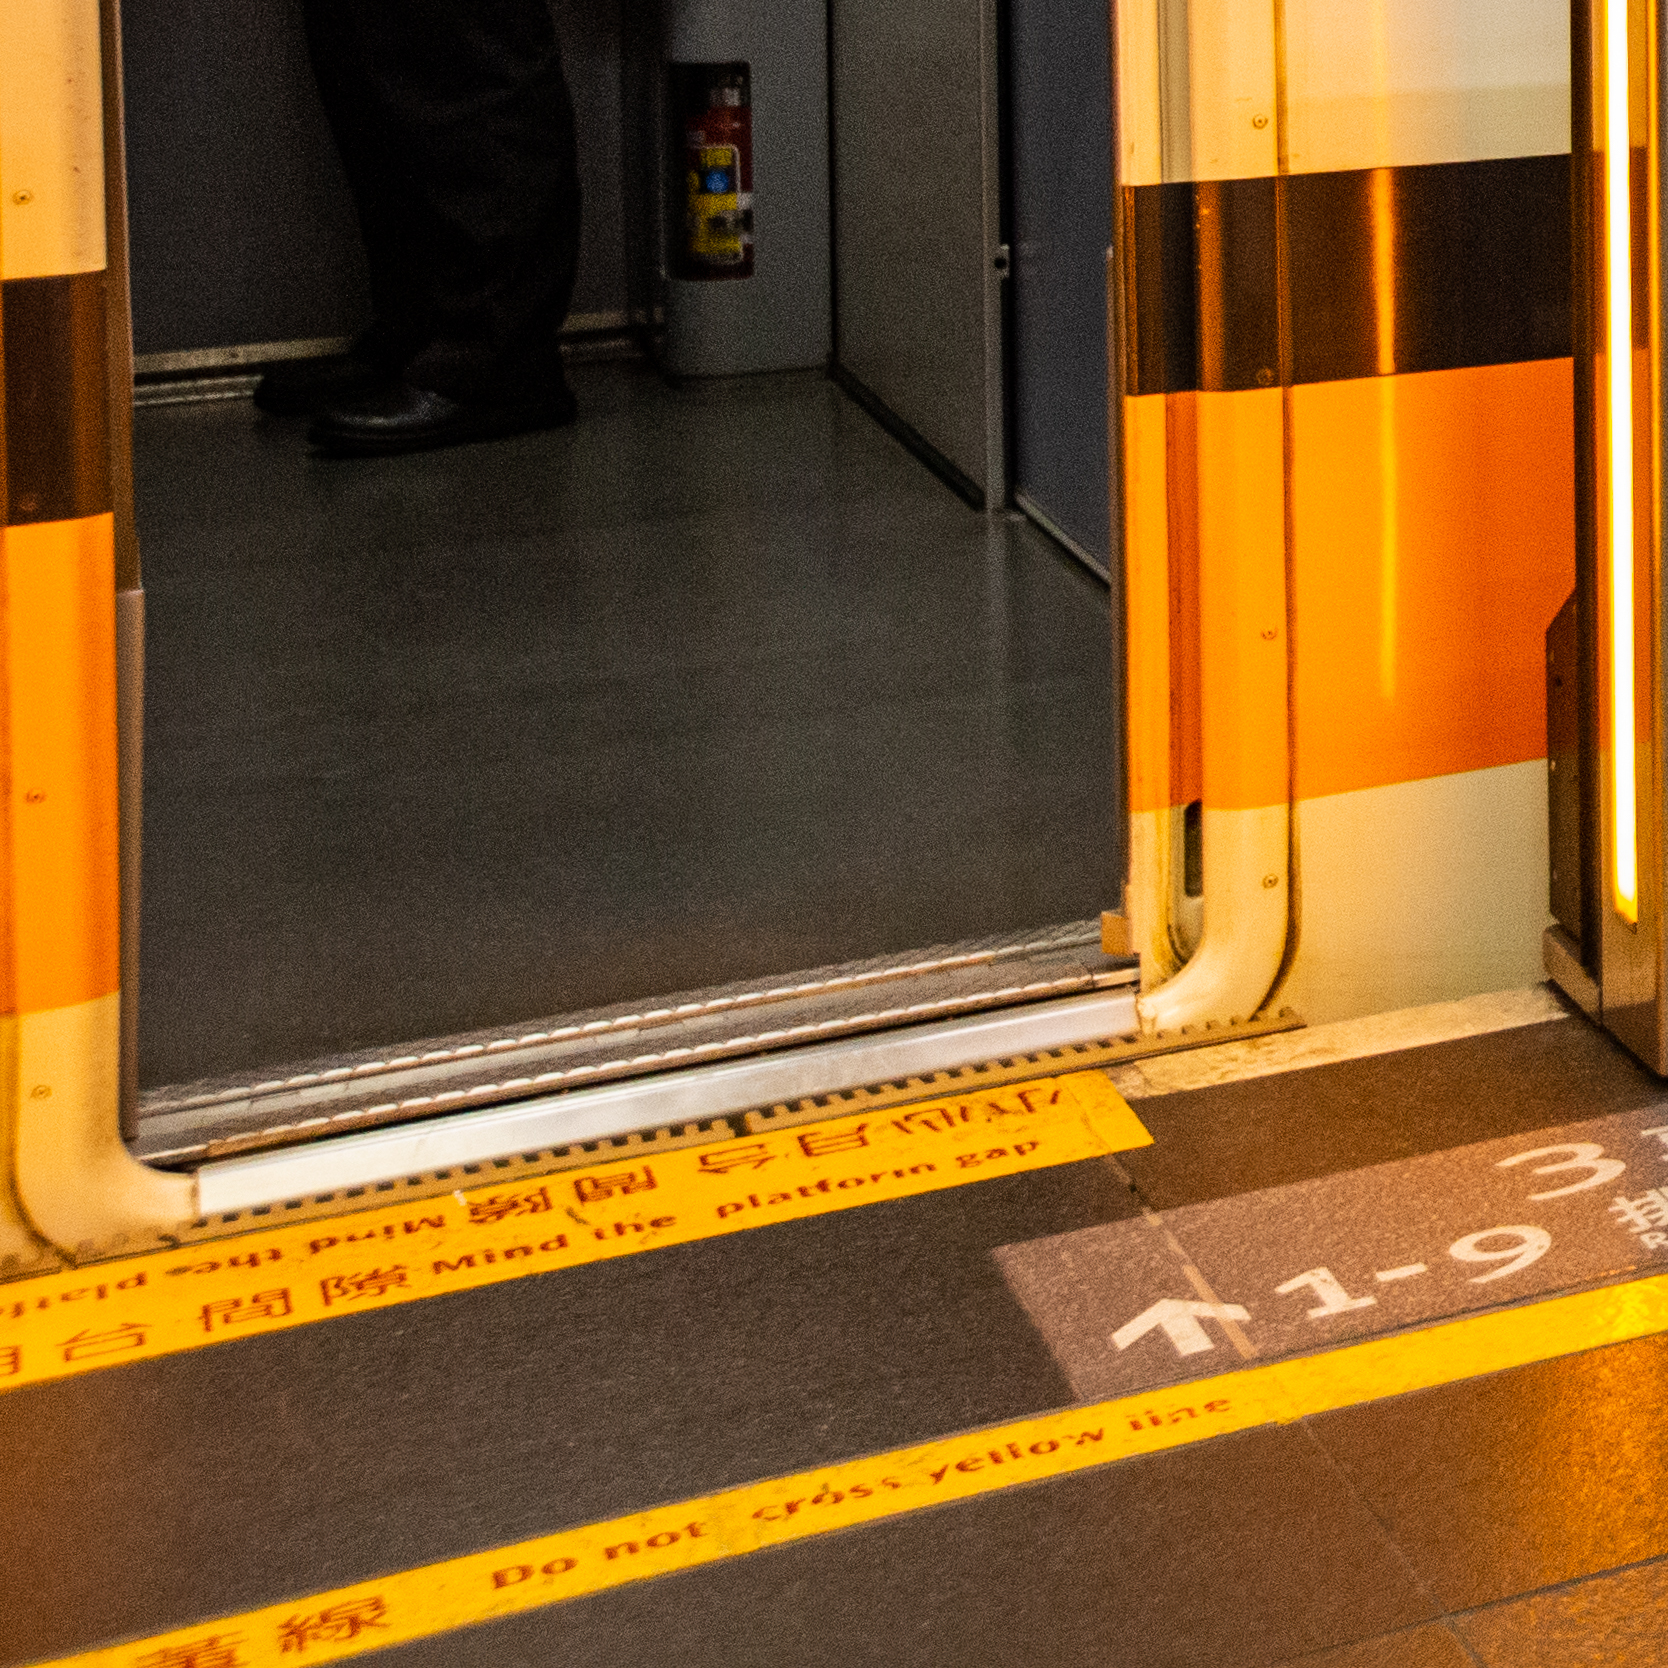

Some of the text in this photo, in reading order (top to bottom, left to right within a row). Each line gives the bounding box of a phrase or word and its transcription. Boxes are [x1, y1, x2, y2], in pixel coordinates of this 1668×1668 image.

[310, 1213, 447, 1255] Mind
[432, 1232, 569, 1274] Mind
[593, 1212, 677, 1242] the
[716, 1158, 937, 1219] platform
[955, 1139, 1041, 1170] gap
[190, 1246, 283, 1275] the
[1275, 1224, 1552, 1320] 1-9
[490, 1555, 579, 1591] Do
[603, 1520, 711, 1561] not
[751, 1474, 903, 1523] cross
[928, 1427, 1105, 1485] yellow
[1129, 1398, 1232, 1433] line
